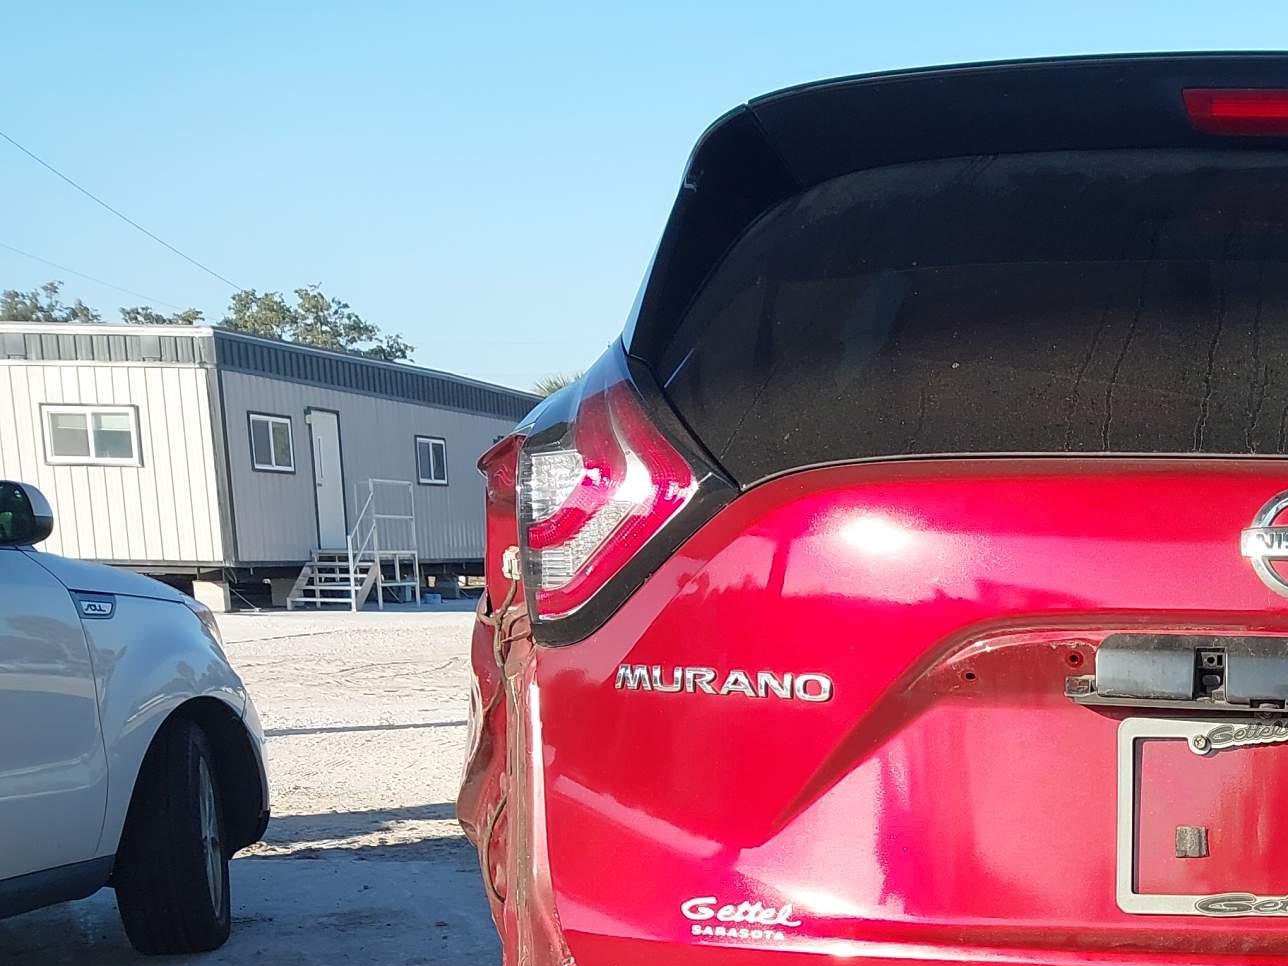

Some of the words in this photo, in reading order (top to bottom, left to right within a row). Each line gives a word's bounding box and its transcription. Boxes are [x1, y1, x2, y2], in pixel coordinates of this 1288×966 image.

[614, 664, 834, 702] MURANO
[680, 896, 802, 927] Gettel
[690, 924, 785, 940] SARASOTA
